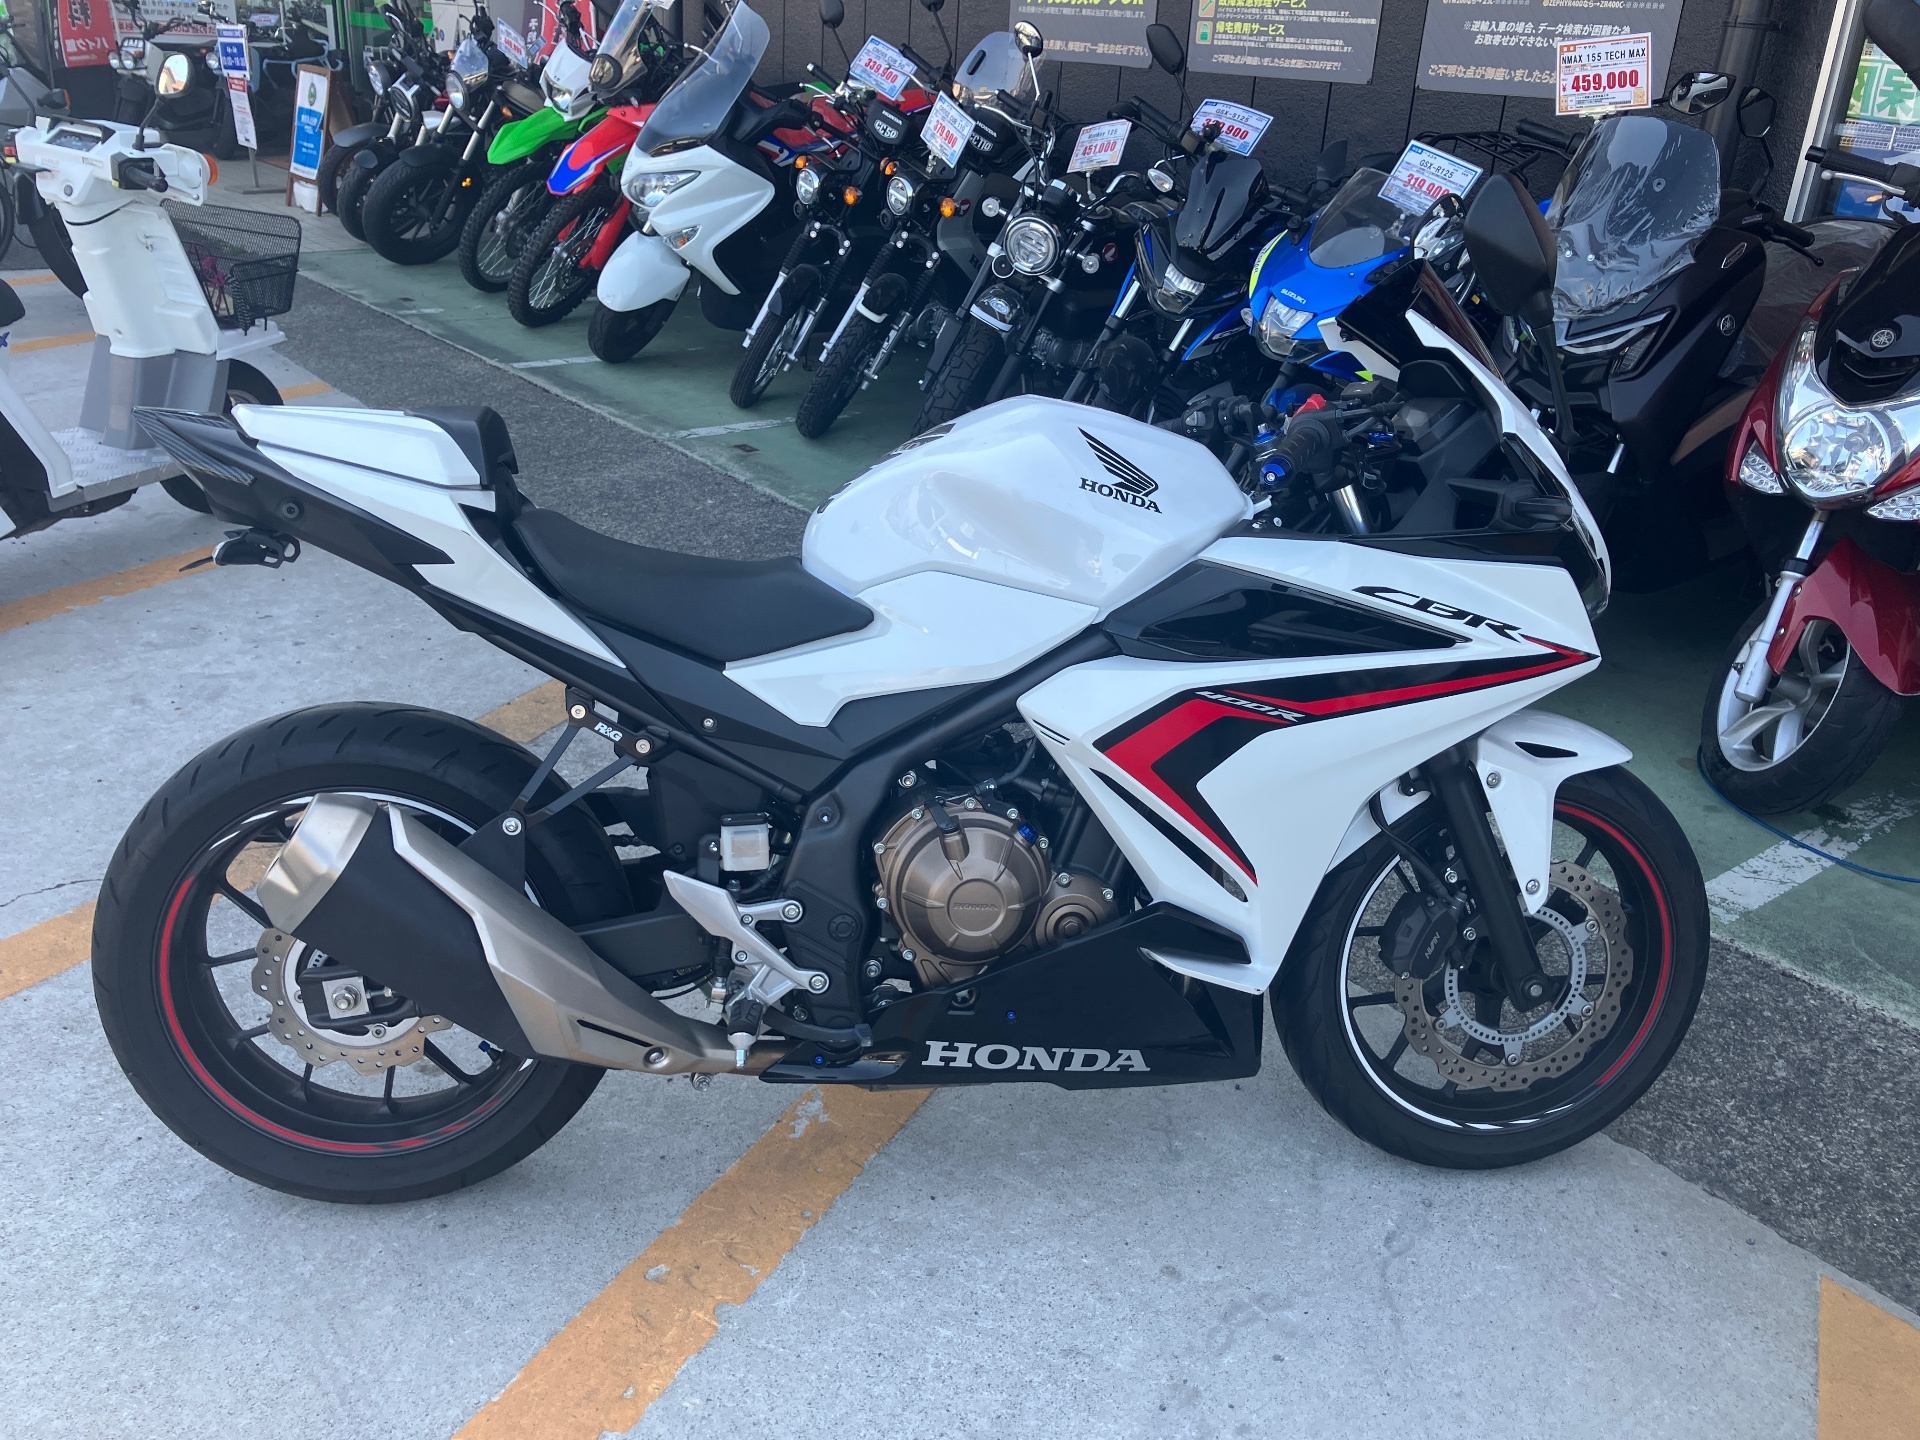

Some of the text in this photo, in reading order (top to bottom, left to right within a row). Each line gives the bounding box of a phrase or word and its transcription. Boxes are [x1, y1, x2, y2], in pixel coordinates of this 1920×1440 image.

[1216, 21, 1285, 35] 帰宅費用サービス
[1474, 33, 1577, 48] お取寄せができない事
[873, 46, 888, 60] CROSS
[888, 55, 898, 65] CUB
[1562, 54, 1583, 65] NMAX
[1587, 52, 1602, 62] 155
[1605, 50, 1626, 61] TECH
[1629, 47, 1646, 58] MAX
[864, 57, 899, 84] 339,900
[1572, 69, 1639, 92] 459,000
[882, 110, 902, 125] HONDA
[1215, 108, 1250, 123] GSX-S125
[875, 121, 898, 139] CC50
[933, 120, 959, 148] 379,900
[976, 120, 998, 137] HONDA
[1107, 128, 1118, 136] 125
[1081, 140, 1117, 156] 451,000
[1419, 159, 1454, 179] GSX-R125
[1280, 288, 1307, 305] SUZUKI
[1078, 477, 1163, 514] HONDA
[1352, 585, 1522, 643] CBR
[1195, 690, 1305, 723] 400R
[594, 721, 623, 742] R&G
[953, 902, 999, 911] HONDA
[921, 1040, 1151, 1072] HONDA
